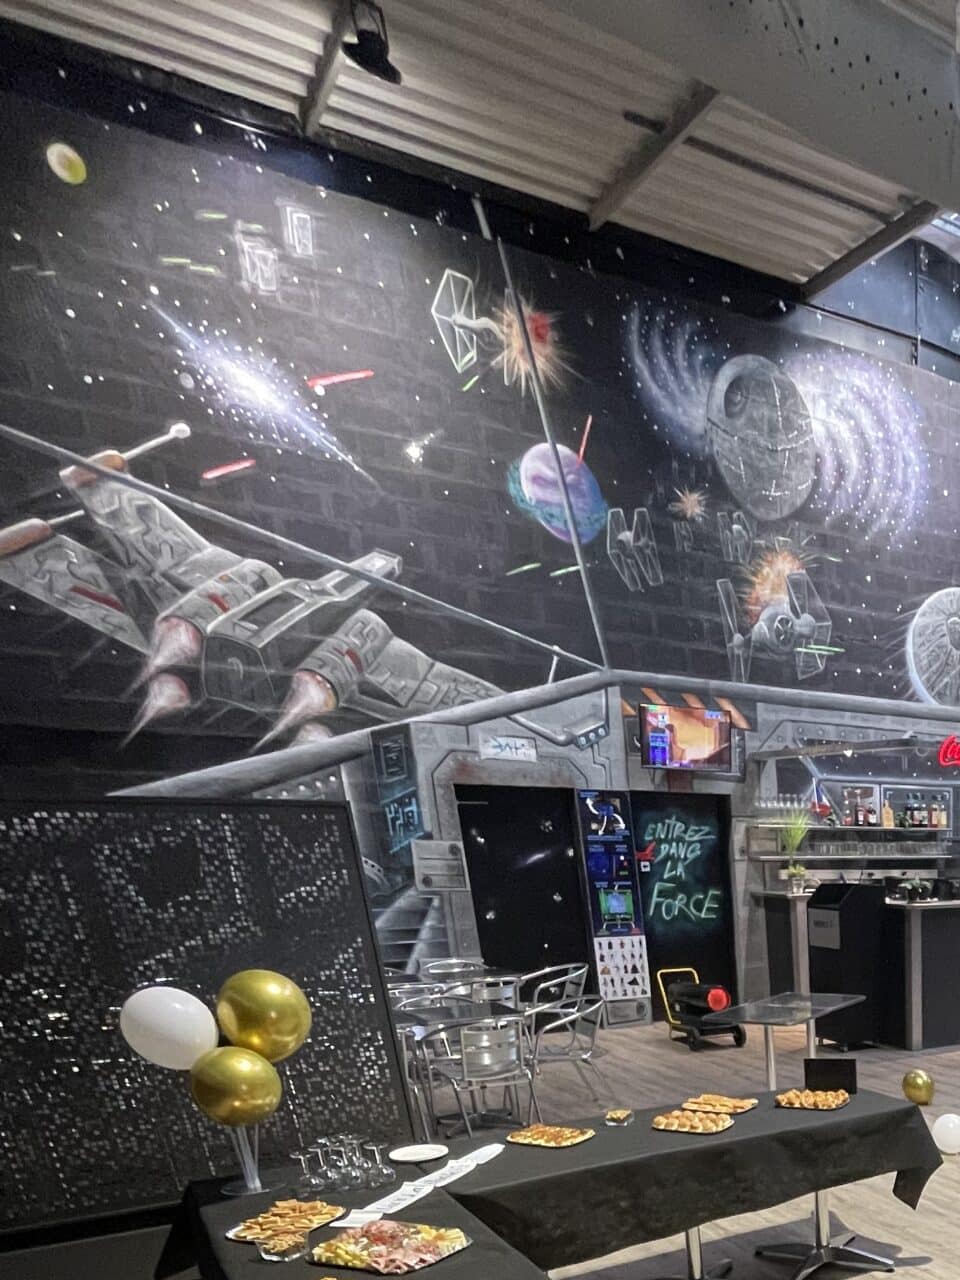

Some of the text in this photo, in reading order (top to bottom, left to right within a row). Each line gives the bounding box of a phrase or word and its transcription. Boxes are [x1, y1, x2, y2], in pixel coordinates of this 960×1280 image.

[645, 816, 717, 840] ENTREZ
[663, 860, 685, 879] LA
[649, 882, 721, 921] FORCE
